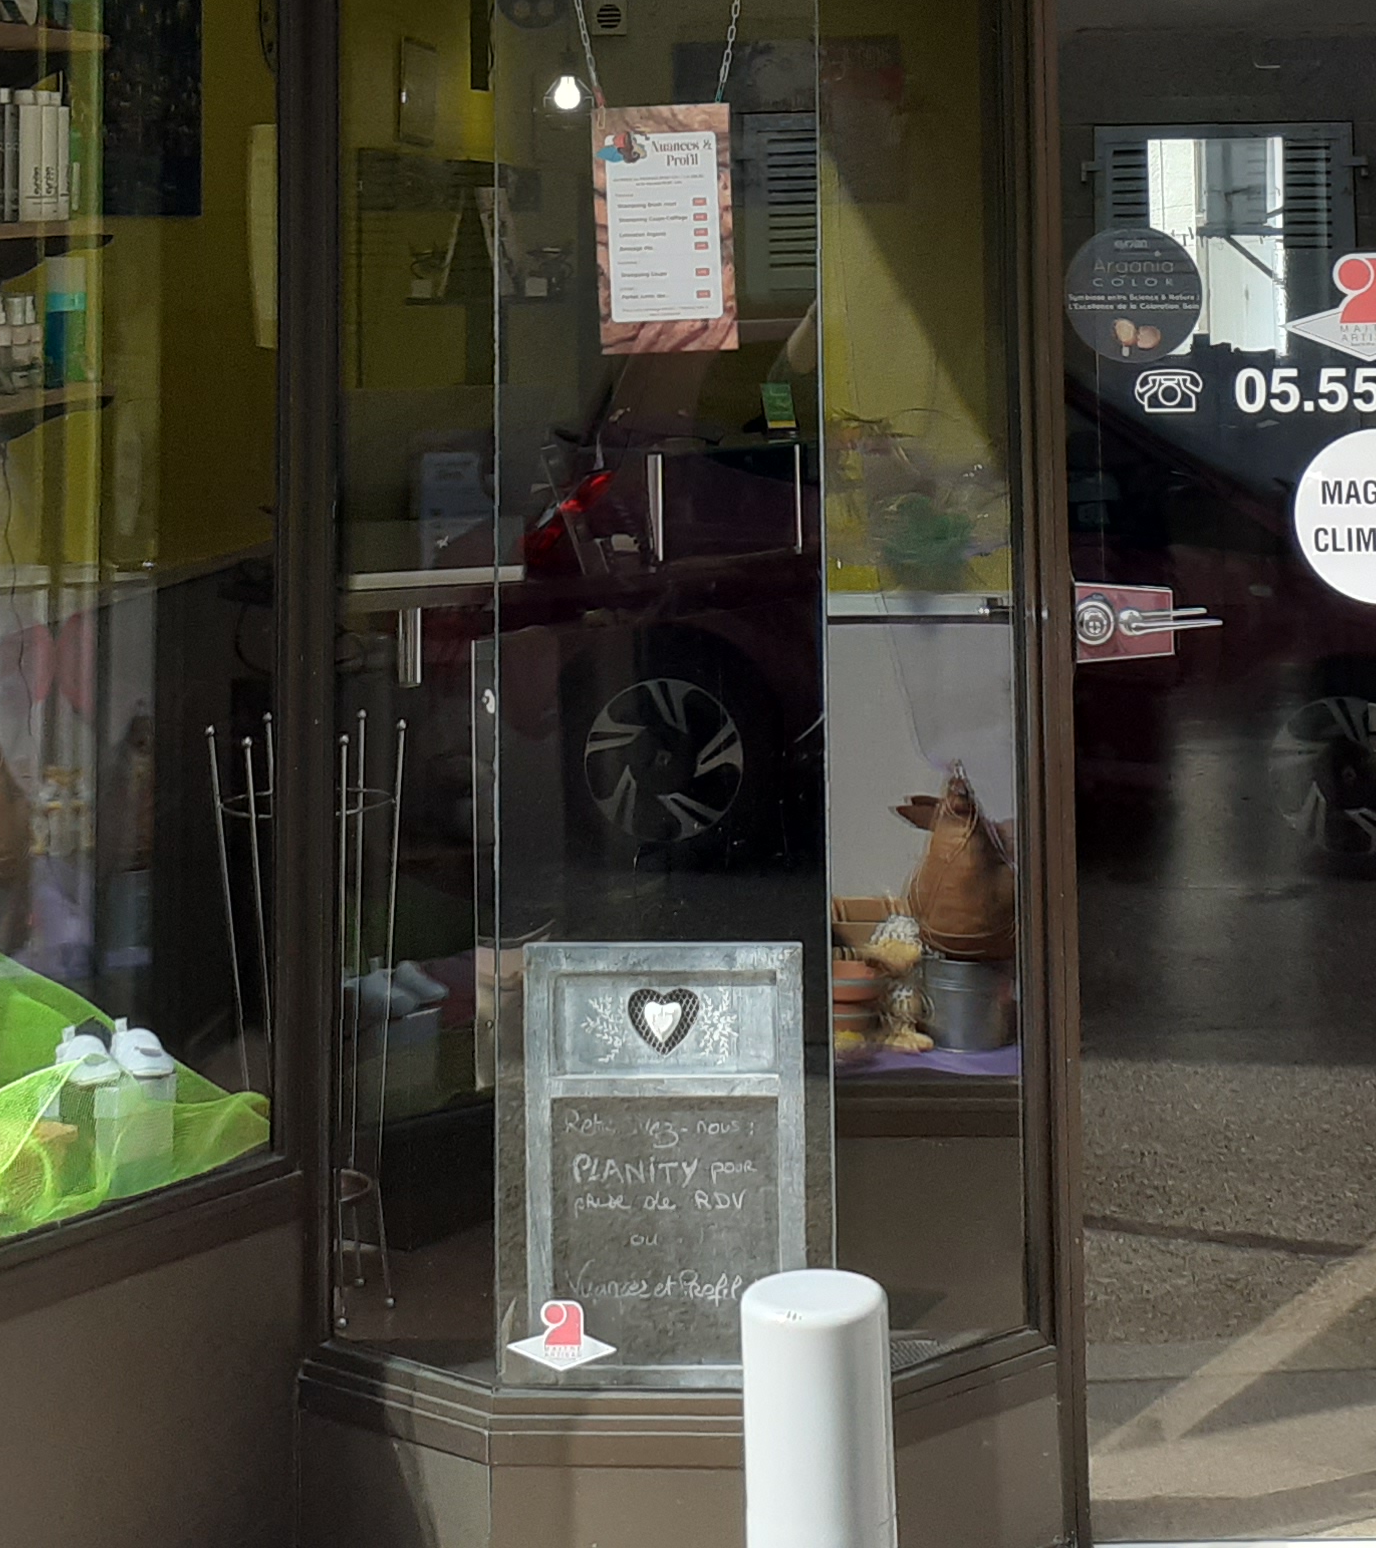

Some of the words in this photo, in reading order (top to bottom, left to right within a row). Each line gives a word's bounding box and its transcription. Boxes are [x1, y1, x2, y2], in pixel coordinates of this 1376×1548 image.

[652, 140, 700, 153] Nuances
[666, 153, 698, 166] Profil
[1092, 277, 1174, 287] COLOR
[695, 1188, 747, 1210] RDV
